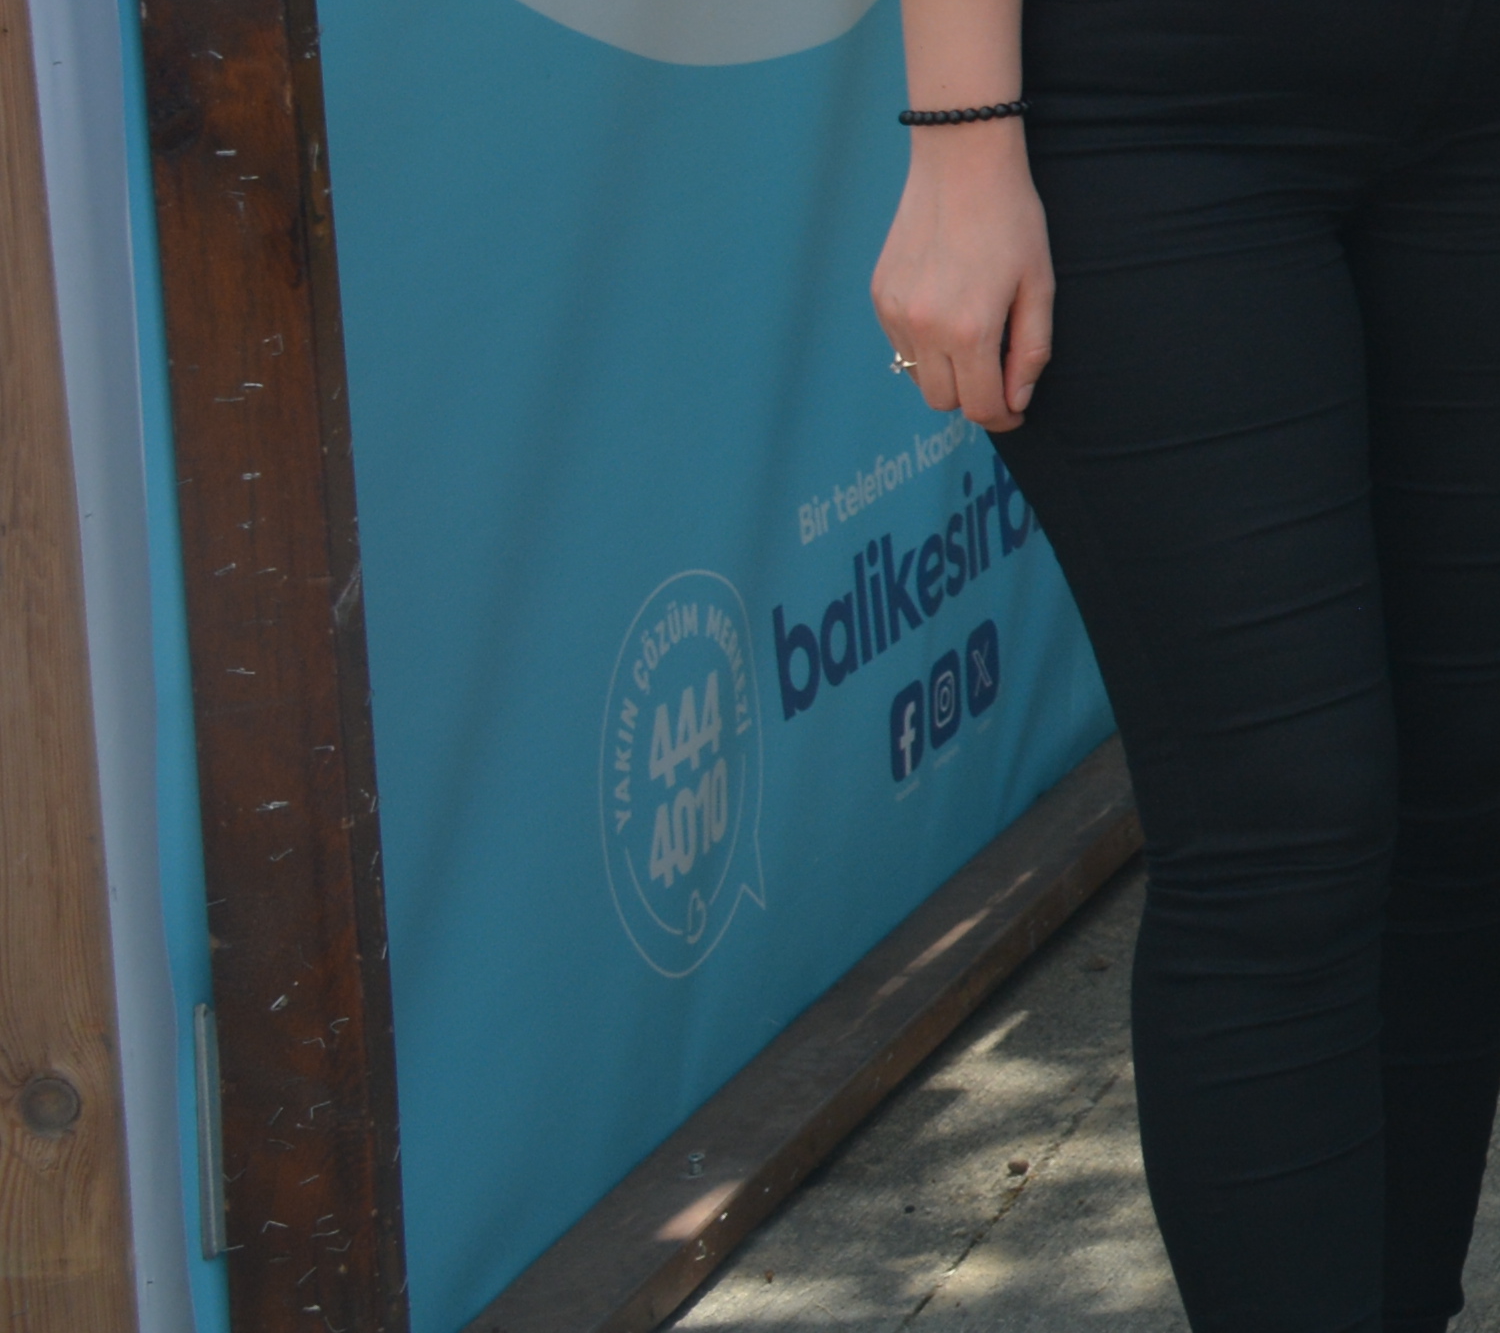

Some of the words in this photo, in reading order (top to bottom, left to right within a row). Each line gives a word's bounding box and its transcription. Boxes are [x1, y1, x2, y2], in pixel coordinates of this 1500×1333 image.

[797, 495, 831, 547] Bir
[833, 452, 913, 523] telefon
[772, 451, 1043, 721] balikesirb
[649, 669, 723, 790] 444
[649, 757, 728, 890] 4010
